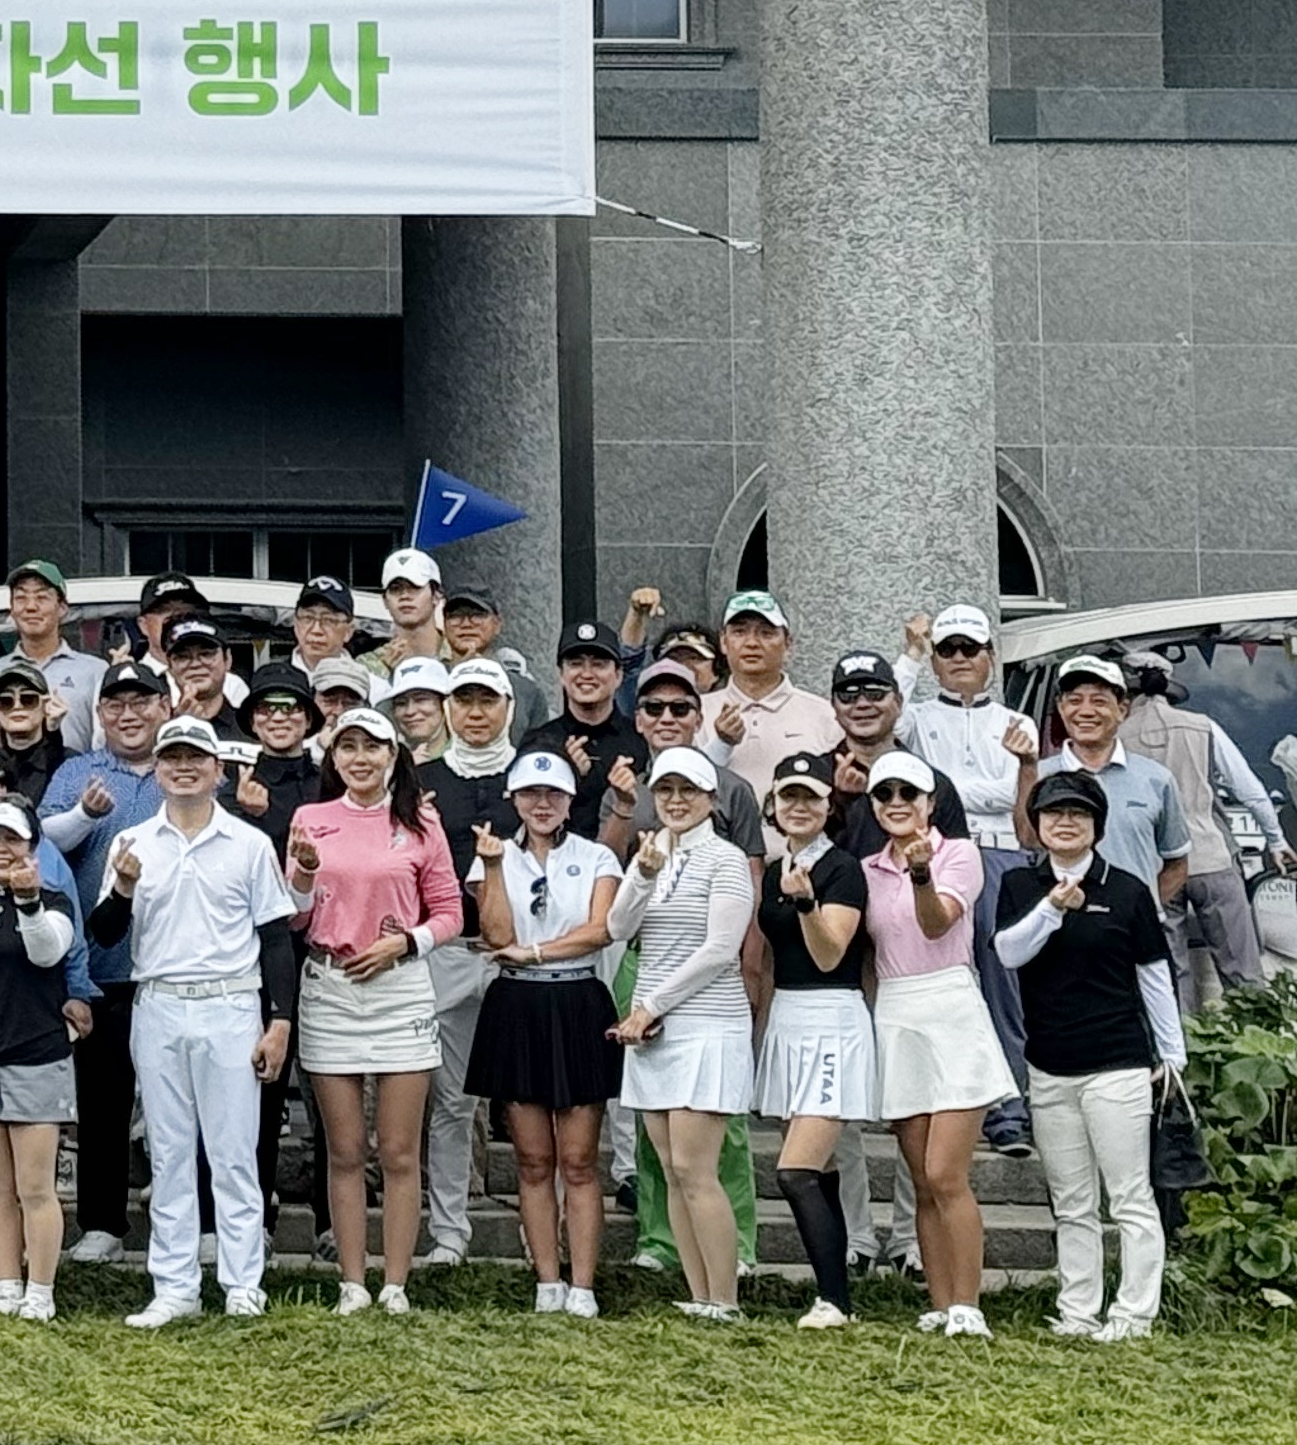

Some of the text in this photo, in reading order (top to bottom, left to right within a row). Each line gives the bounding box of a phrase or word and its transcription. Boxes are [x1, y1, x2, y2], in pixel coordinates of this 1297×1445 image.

[185, 20, 390, 117] 행사
[441, 491, 467, 525] 7
[819, 1053, 837, 1106] UTAA
